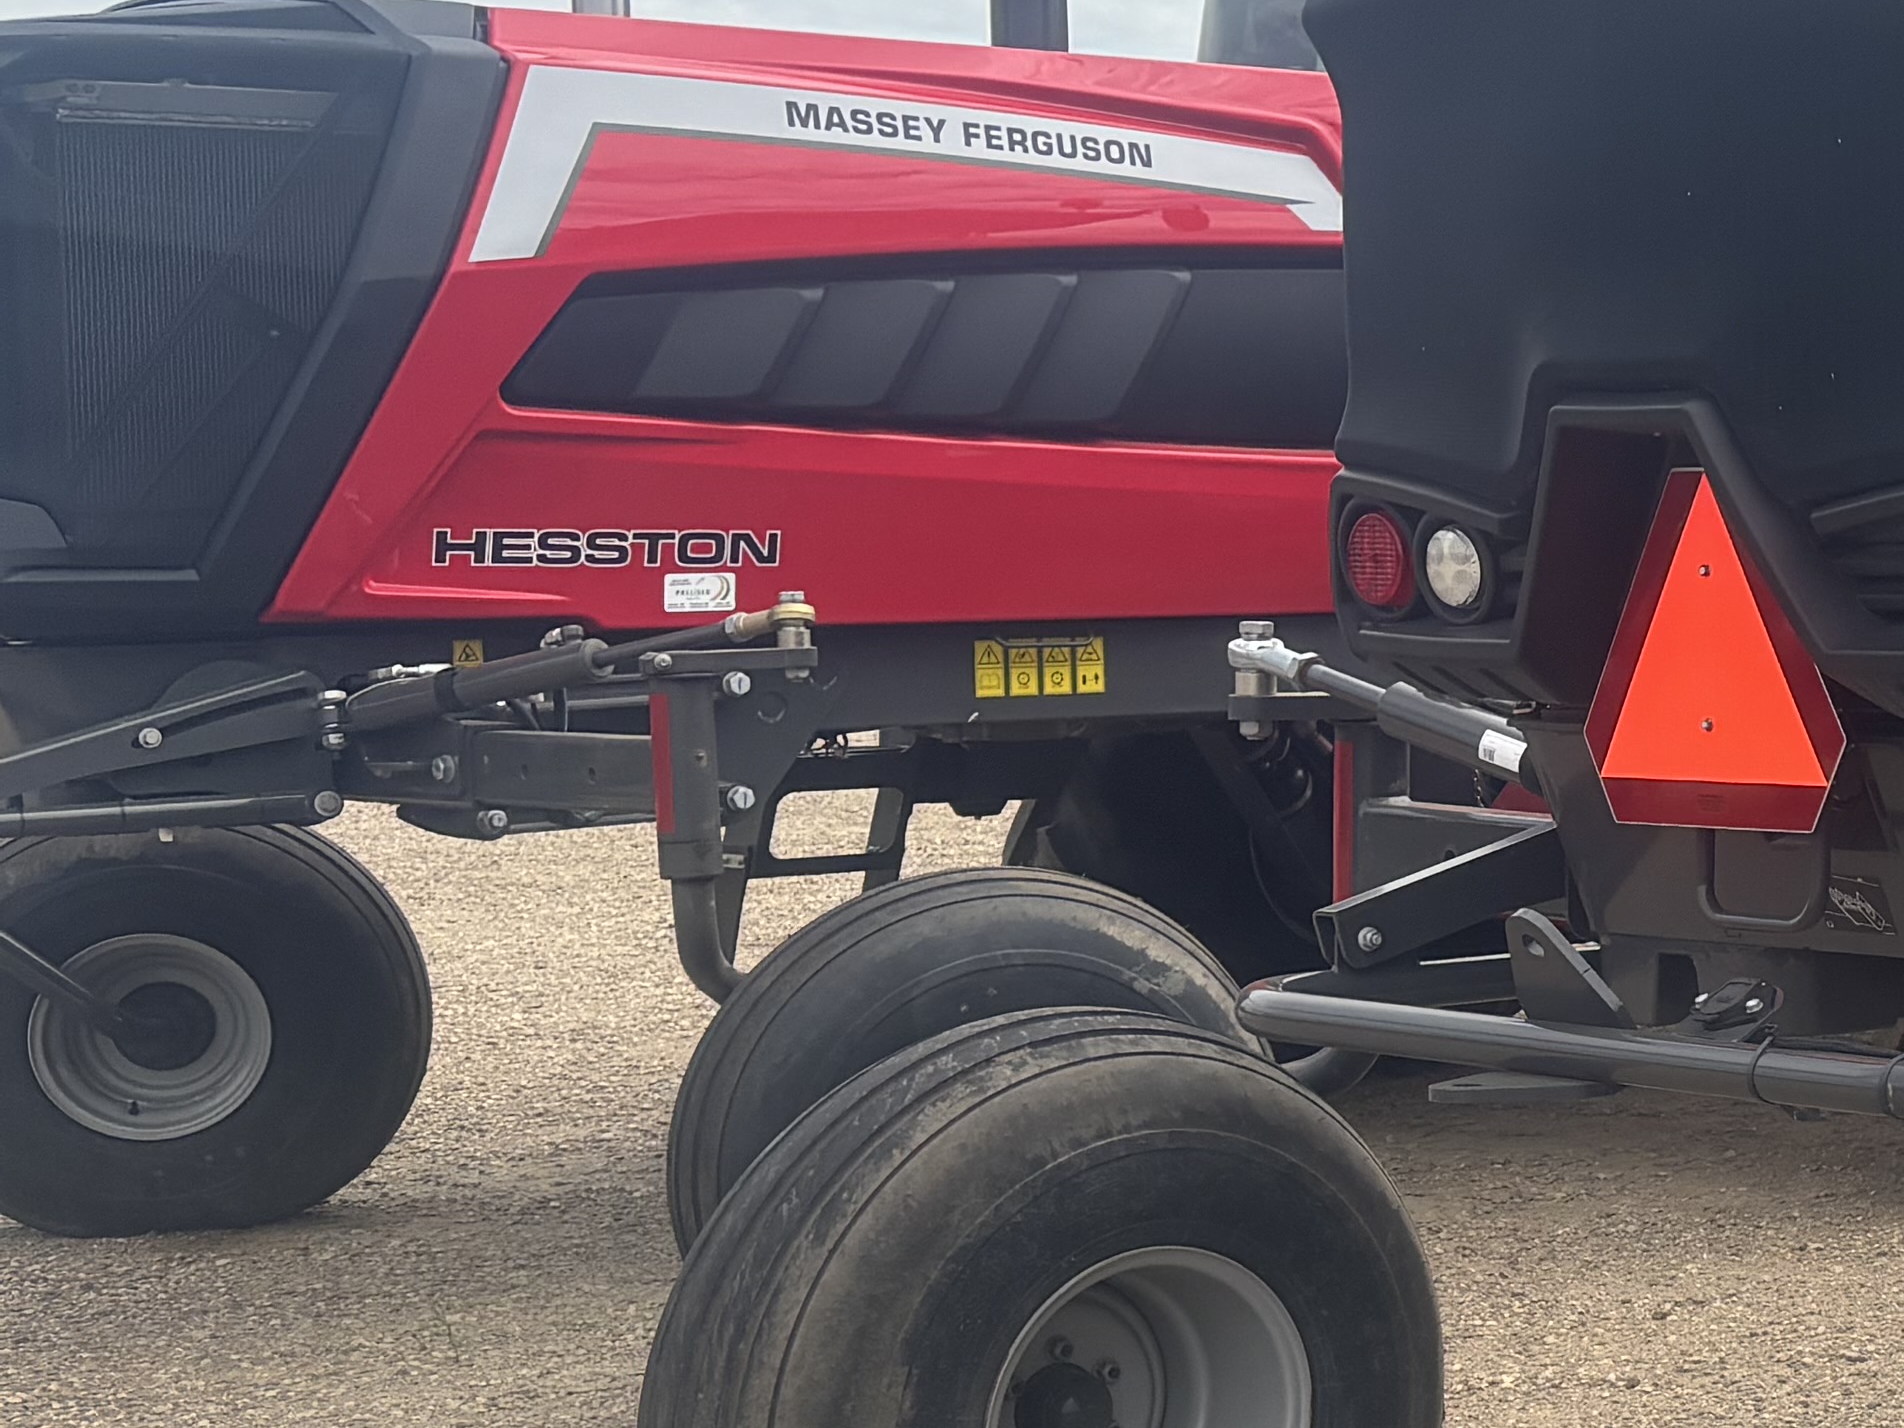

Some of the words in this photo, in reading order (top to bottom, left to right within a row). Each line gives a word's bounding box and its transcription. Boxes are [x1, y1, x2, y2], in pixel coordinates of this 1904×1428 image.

[785, 101, 946, 143] MASSEY
[962, 121, 1153, 168] FERGUSON
[432, 528, 781, 567] HESSTON
